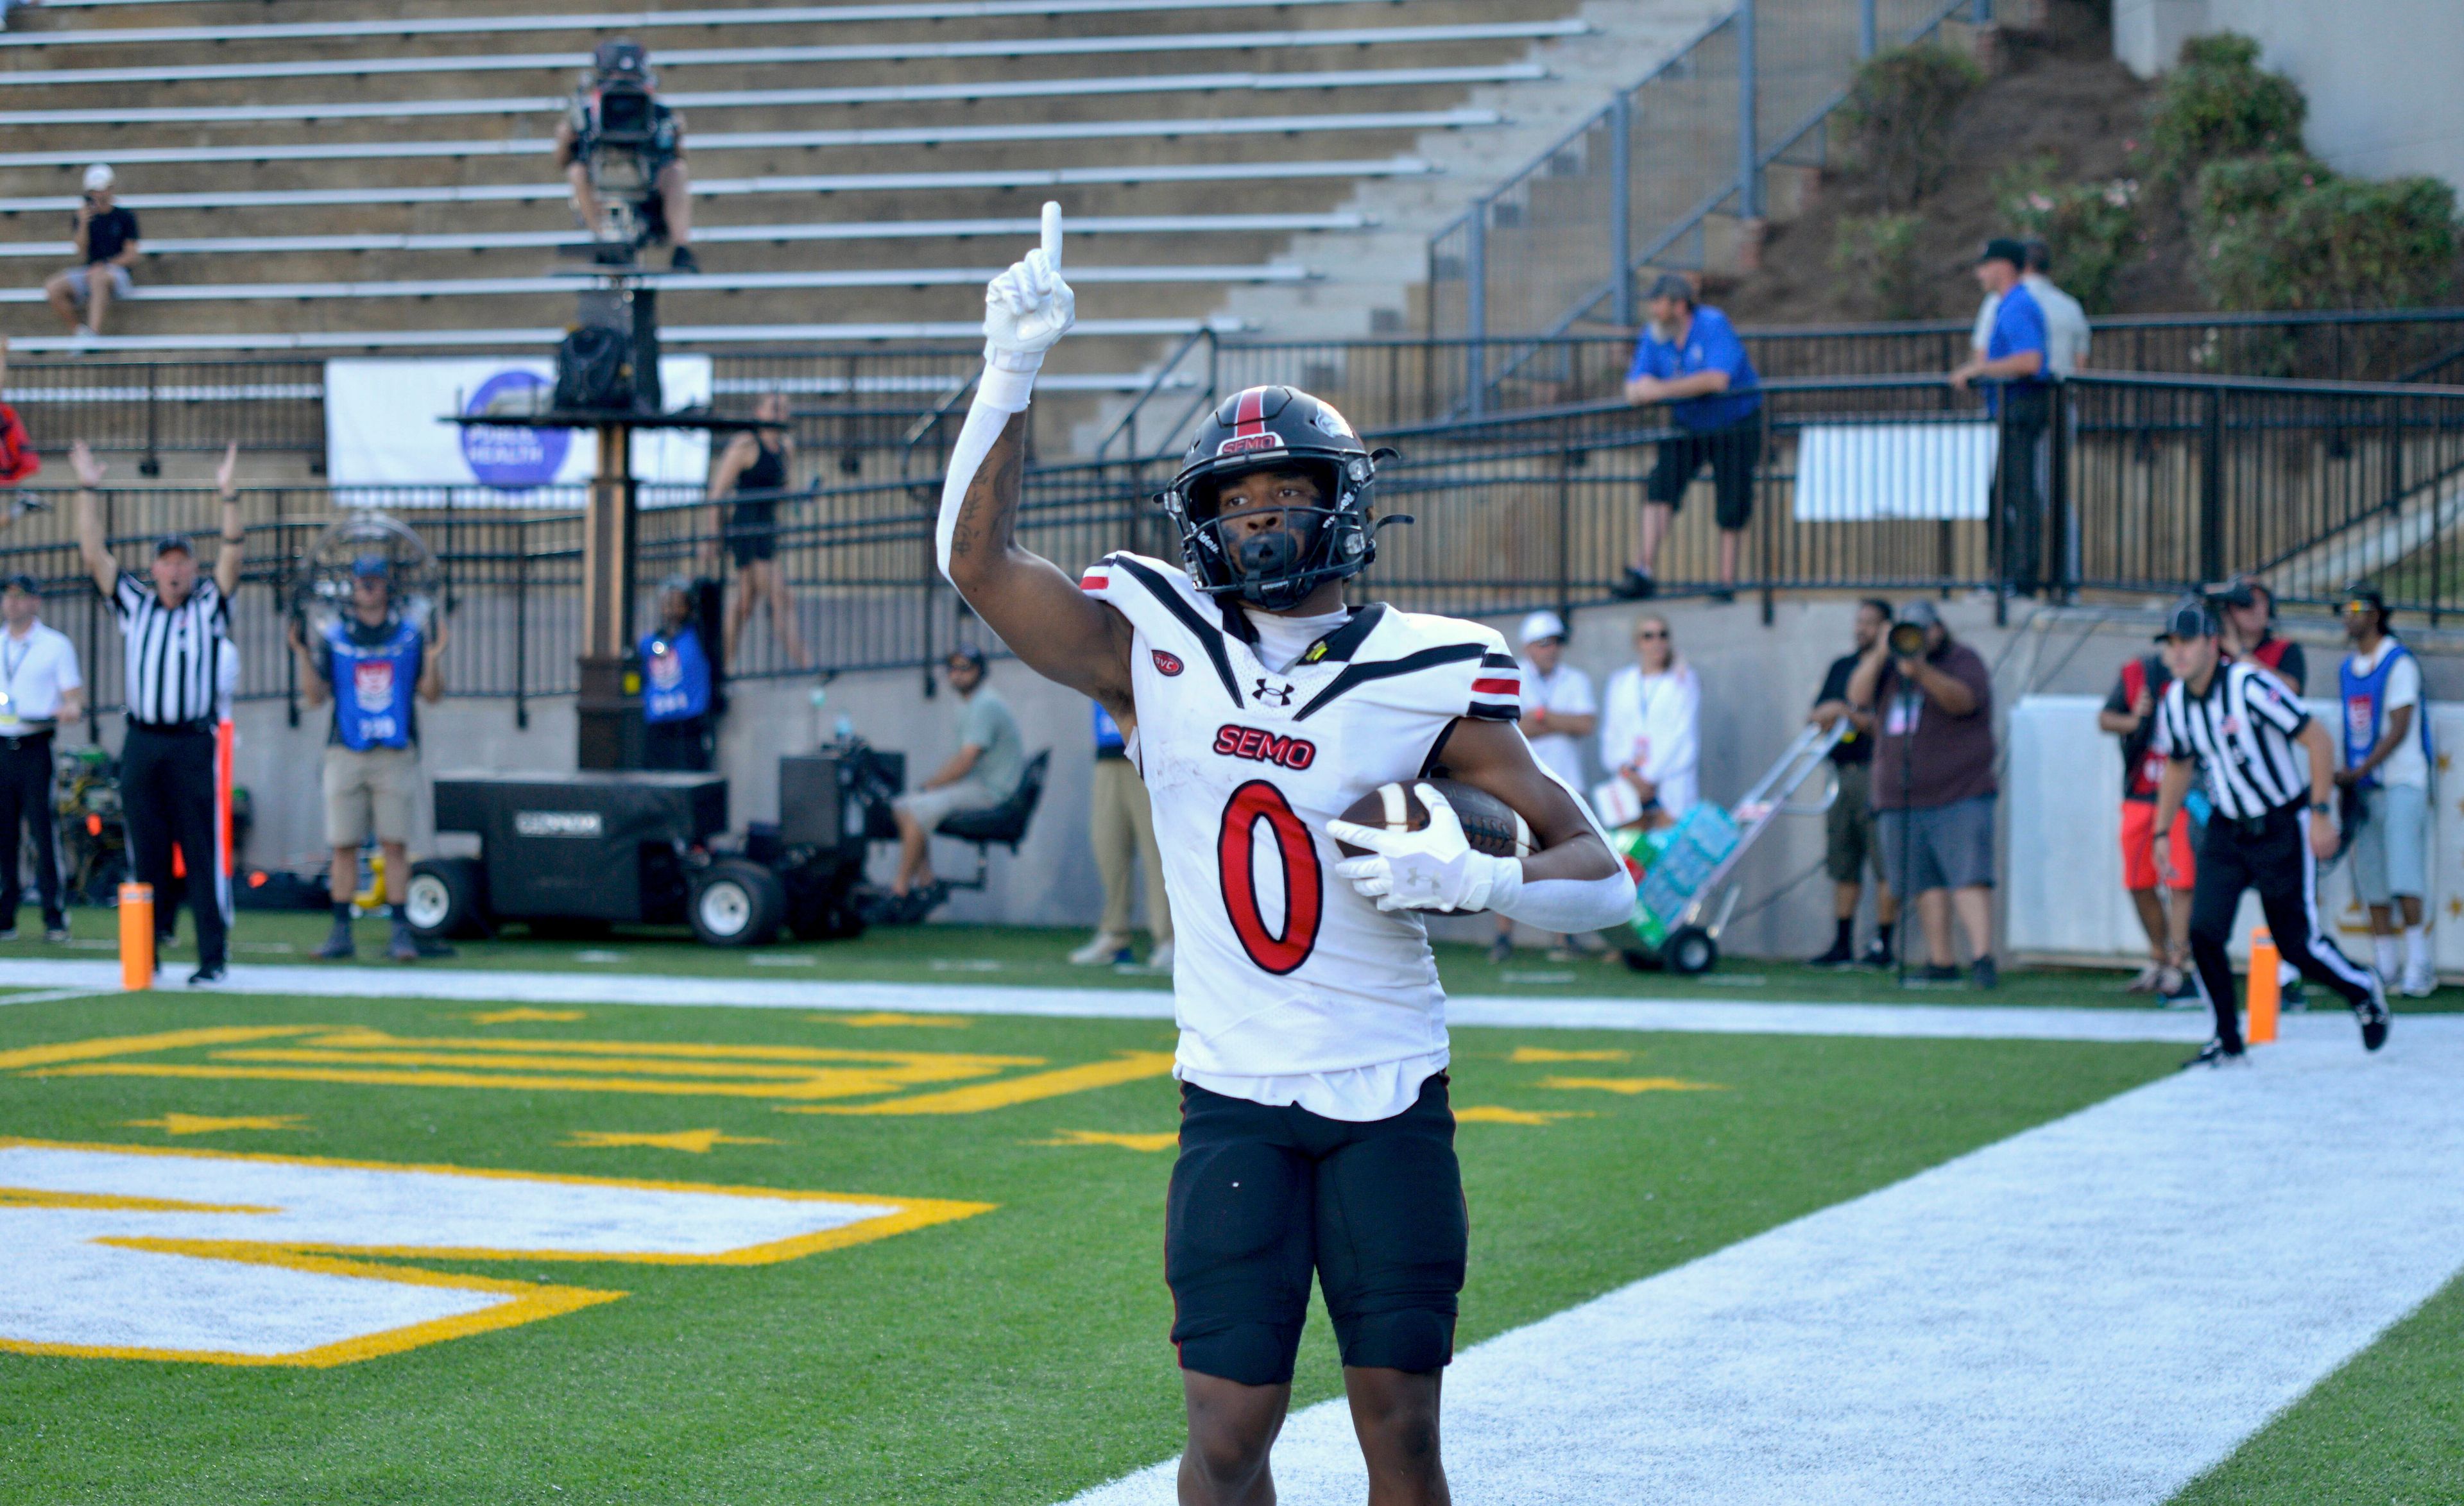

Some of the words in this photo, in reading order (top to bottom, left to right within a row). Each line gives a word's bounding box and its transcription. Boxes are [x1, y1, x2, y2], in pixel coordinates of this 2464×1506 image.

[1222, 435, 1276, 454] SEMO
[1213, 724, 1316, 770] SEMO
[1217, 779, 1323, 975] 0
